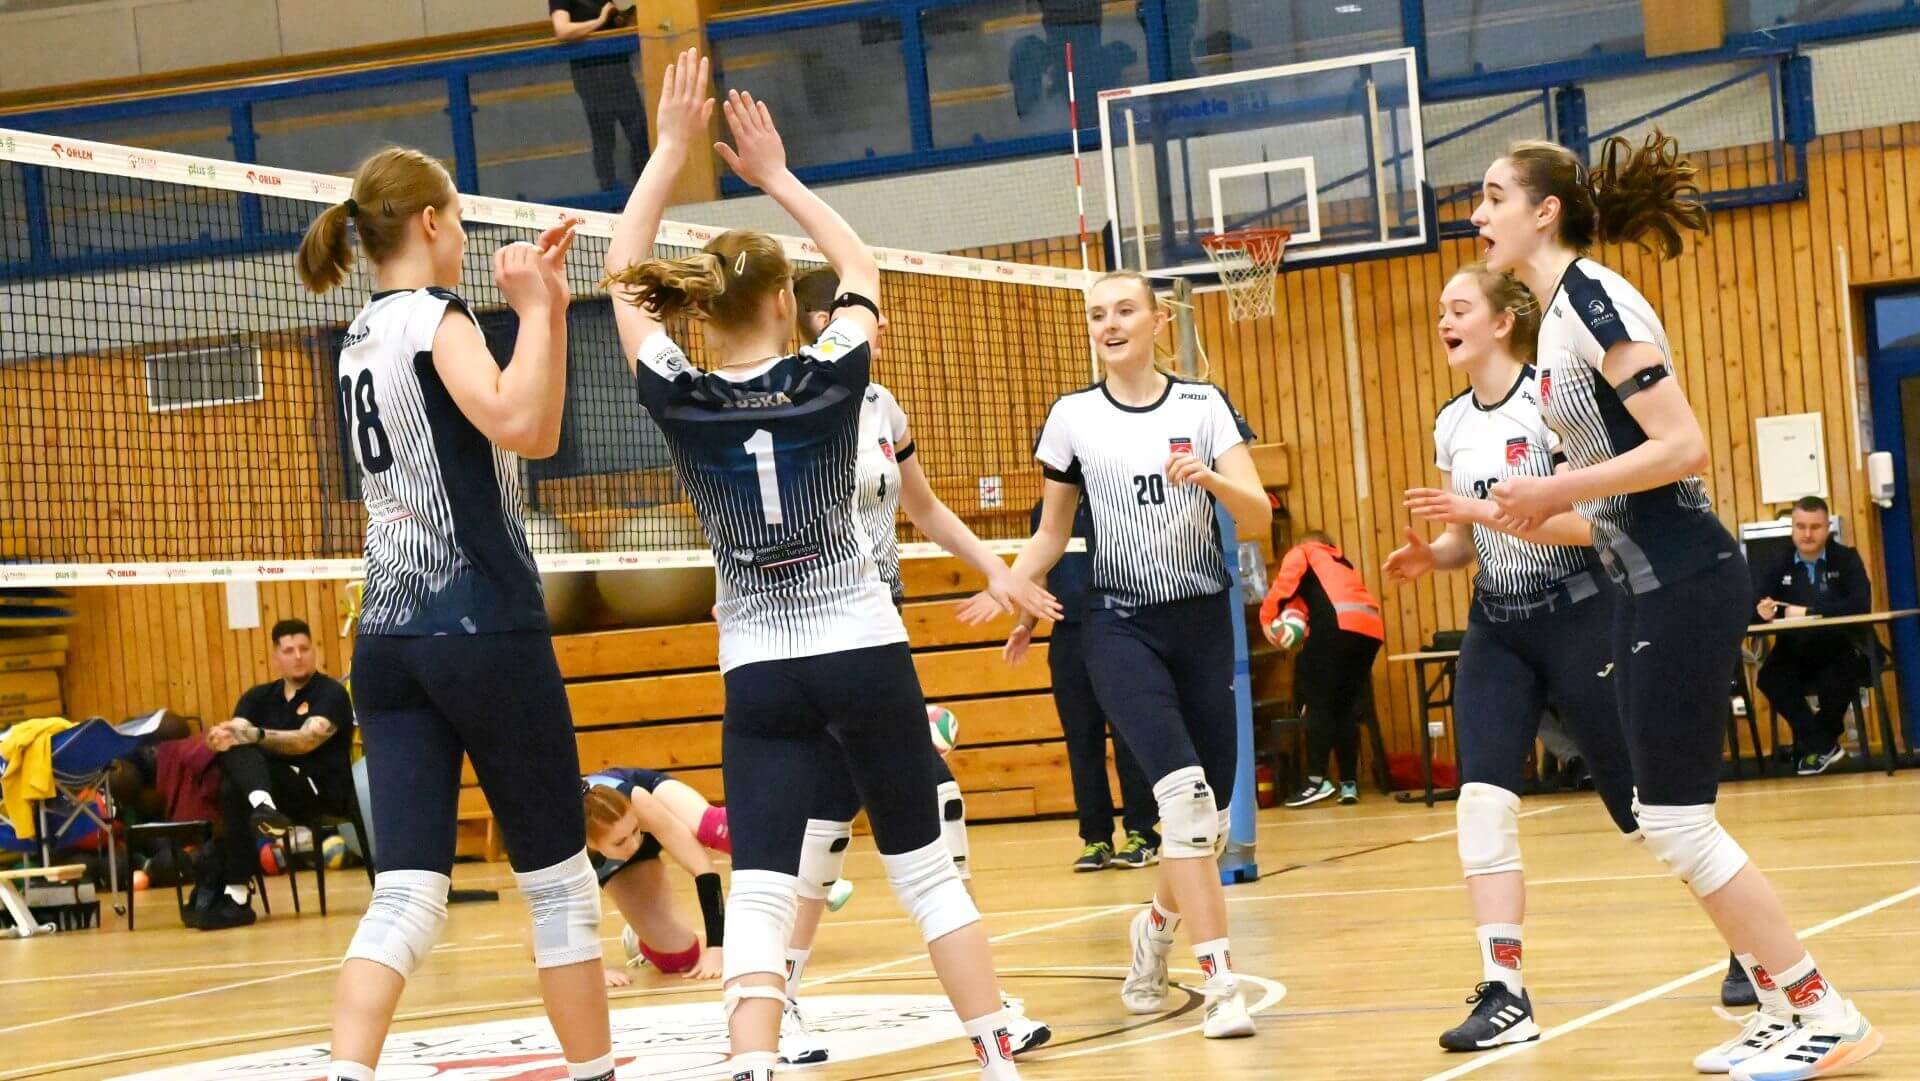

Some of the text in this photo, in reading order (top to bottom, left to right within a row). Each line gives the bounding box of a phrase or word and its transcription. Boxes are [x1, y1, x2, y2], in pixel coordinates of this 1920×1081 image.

[66, 147, 93, 161] ORLEN
[258, 174, 282, 186] ORLEN
[743, 428, 784, 525] 1
[1133, 473, 1166, 506] 20
[117, 570, 137, 578] ORLEN
